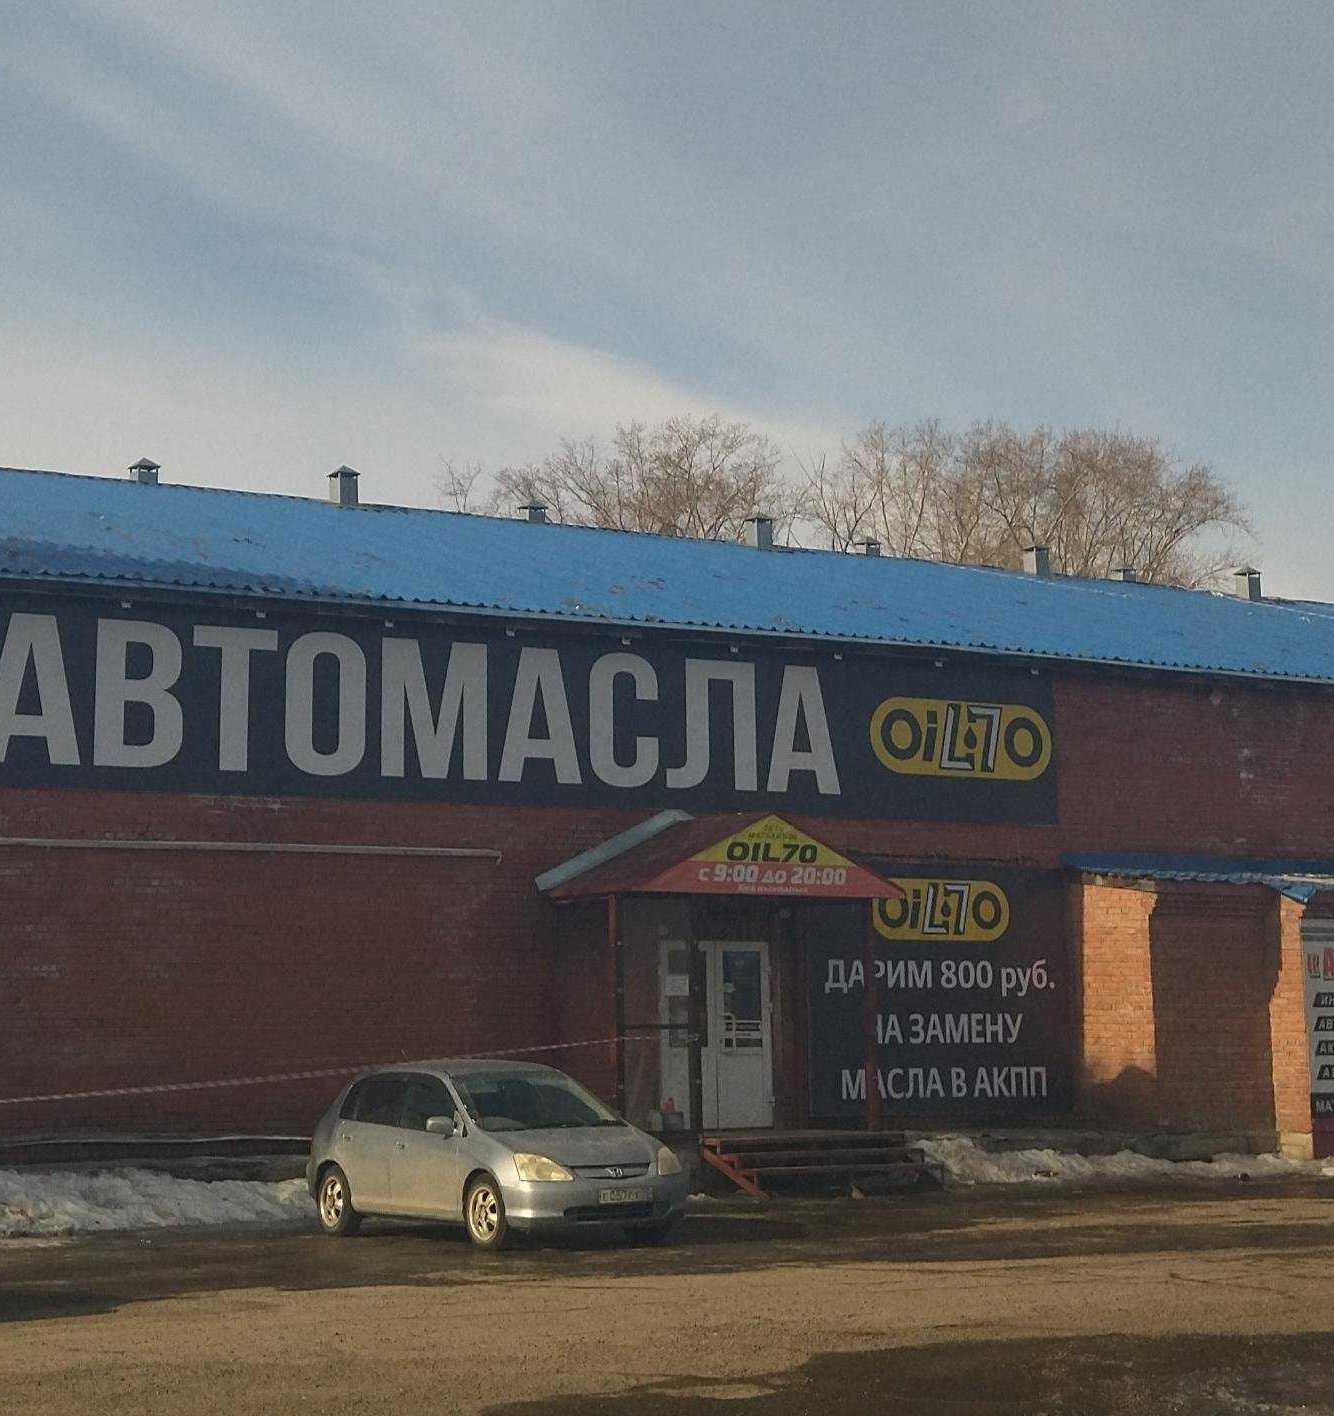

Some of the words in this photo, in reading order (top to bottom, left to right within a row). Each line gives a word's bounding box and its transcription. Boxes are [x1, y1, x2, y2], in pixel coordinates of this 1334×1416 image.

[727, 841, 817, 863] OIL70
[713, 864, 759, 882] 9:00
[791, 867, 847, 885] 20:00
[940, 959, 993, 988] 800
[1000, 958, 1055, 997] руб.
[909, 1013, 1023, 1044] ЗАМЕНУ
[951, 1067, 967, 1098] В
[973, 1066, 1047, 1098] АКПП
